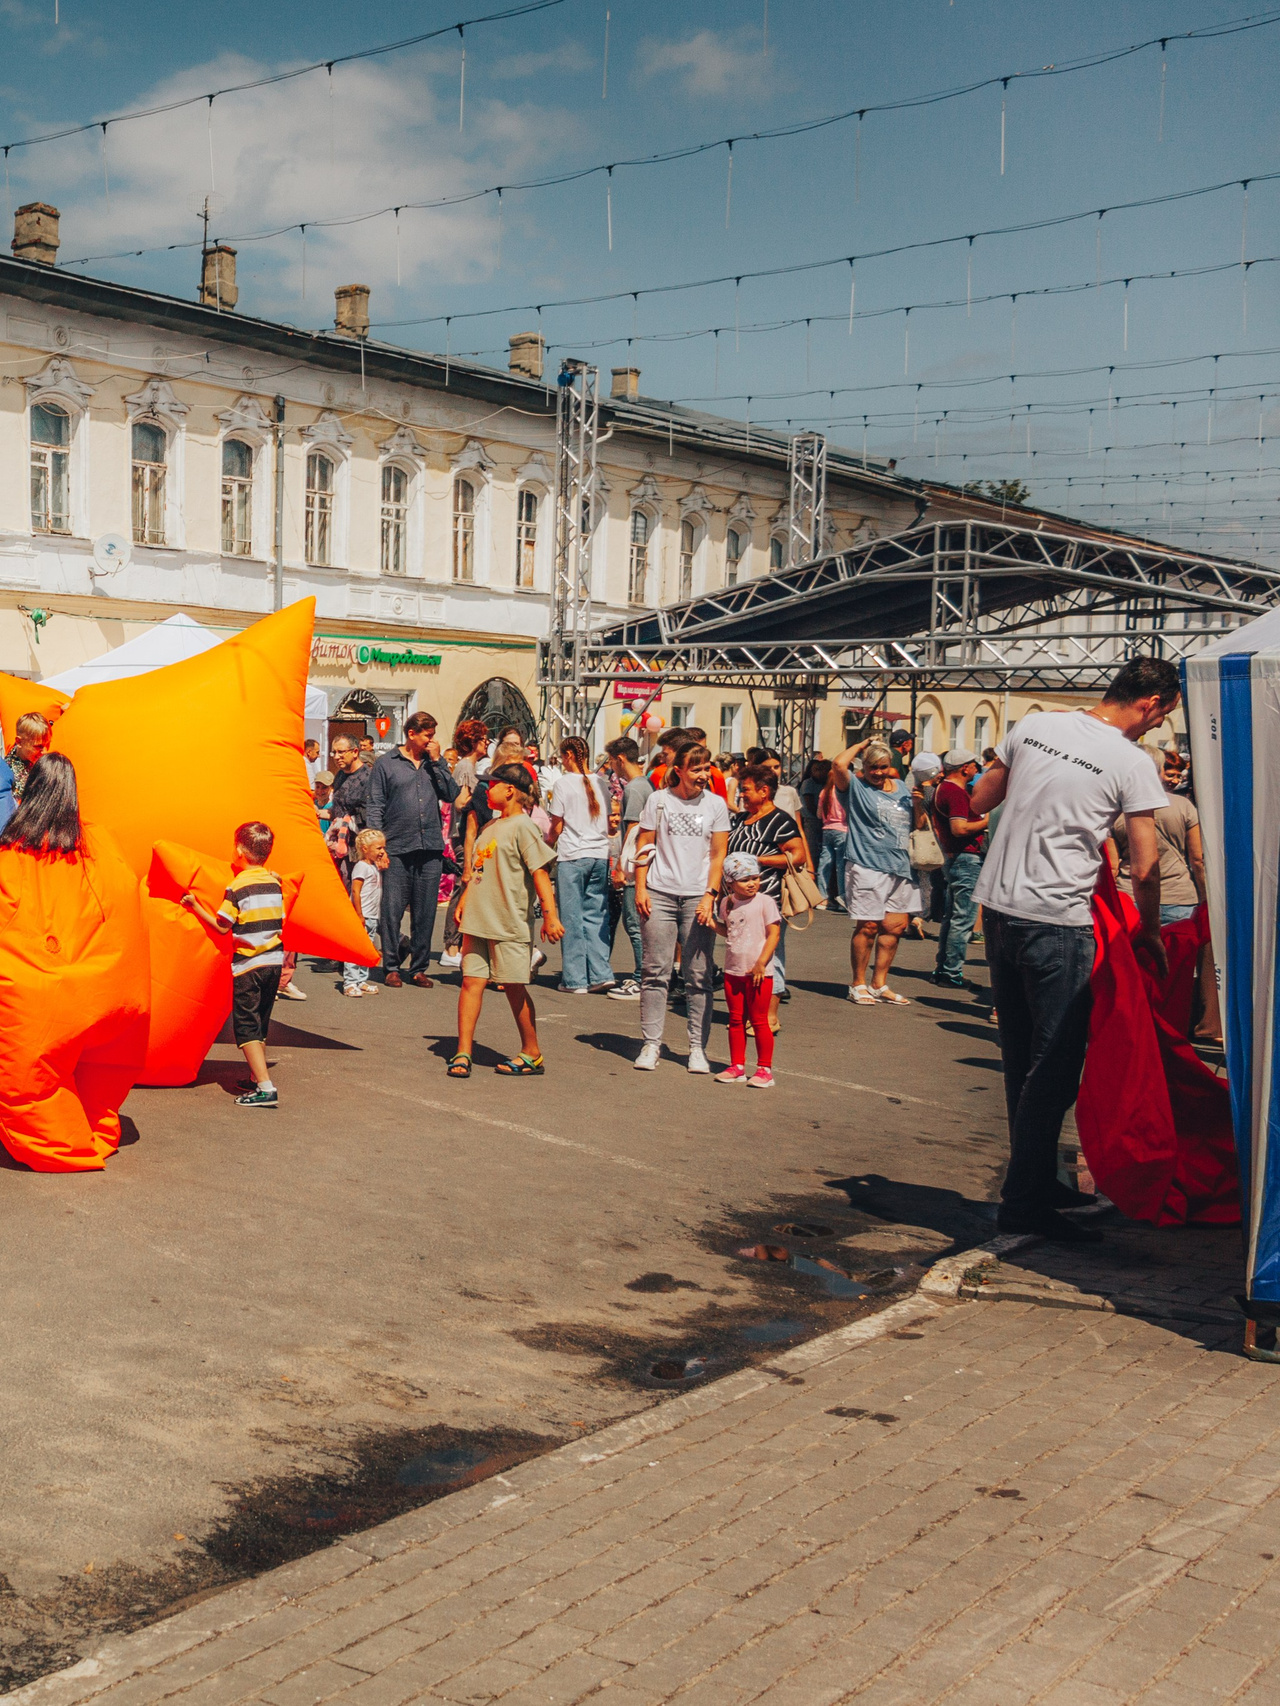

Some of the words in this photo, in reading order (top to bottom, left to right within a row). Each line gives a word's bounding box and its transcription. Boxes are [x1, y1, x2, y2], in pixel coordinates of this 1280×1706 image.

[1023, 737, 1062, 757] BOBYLEV
[1061, 753, 1070, 761] &
[1071, 757, 1104, 776] SHOW
